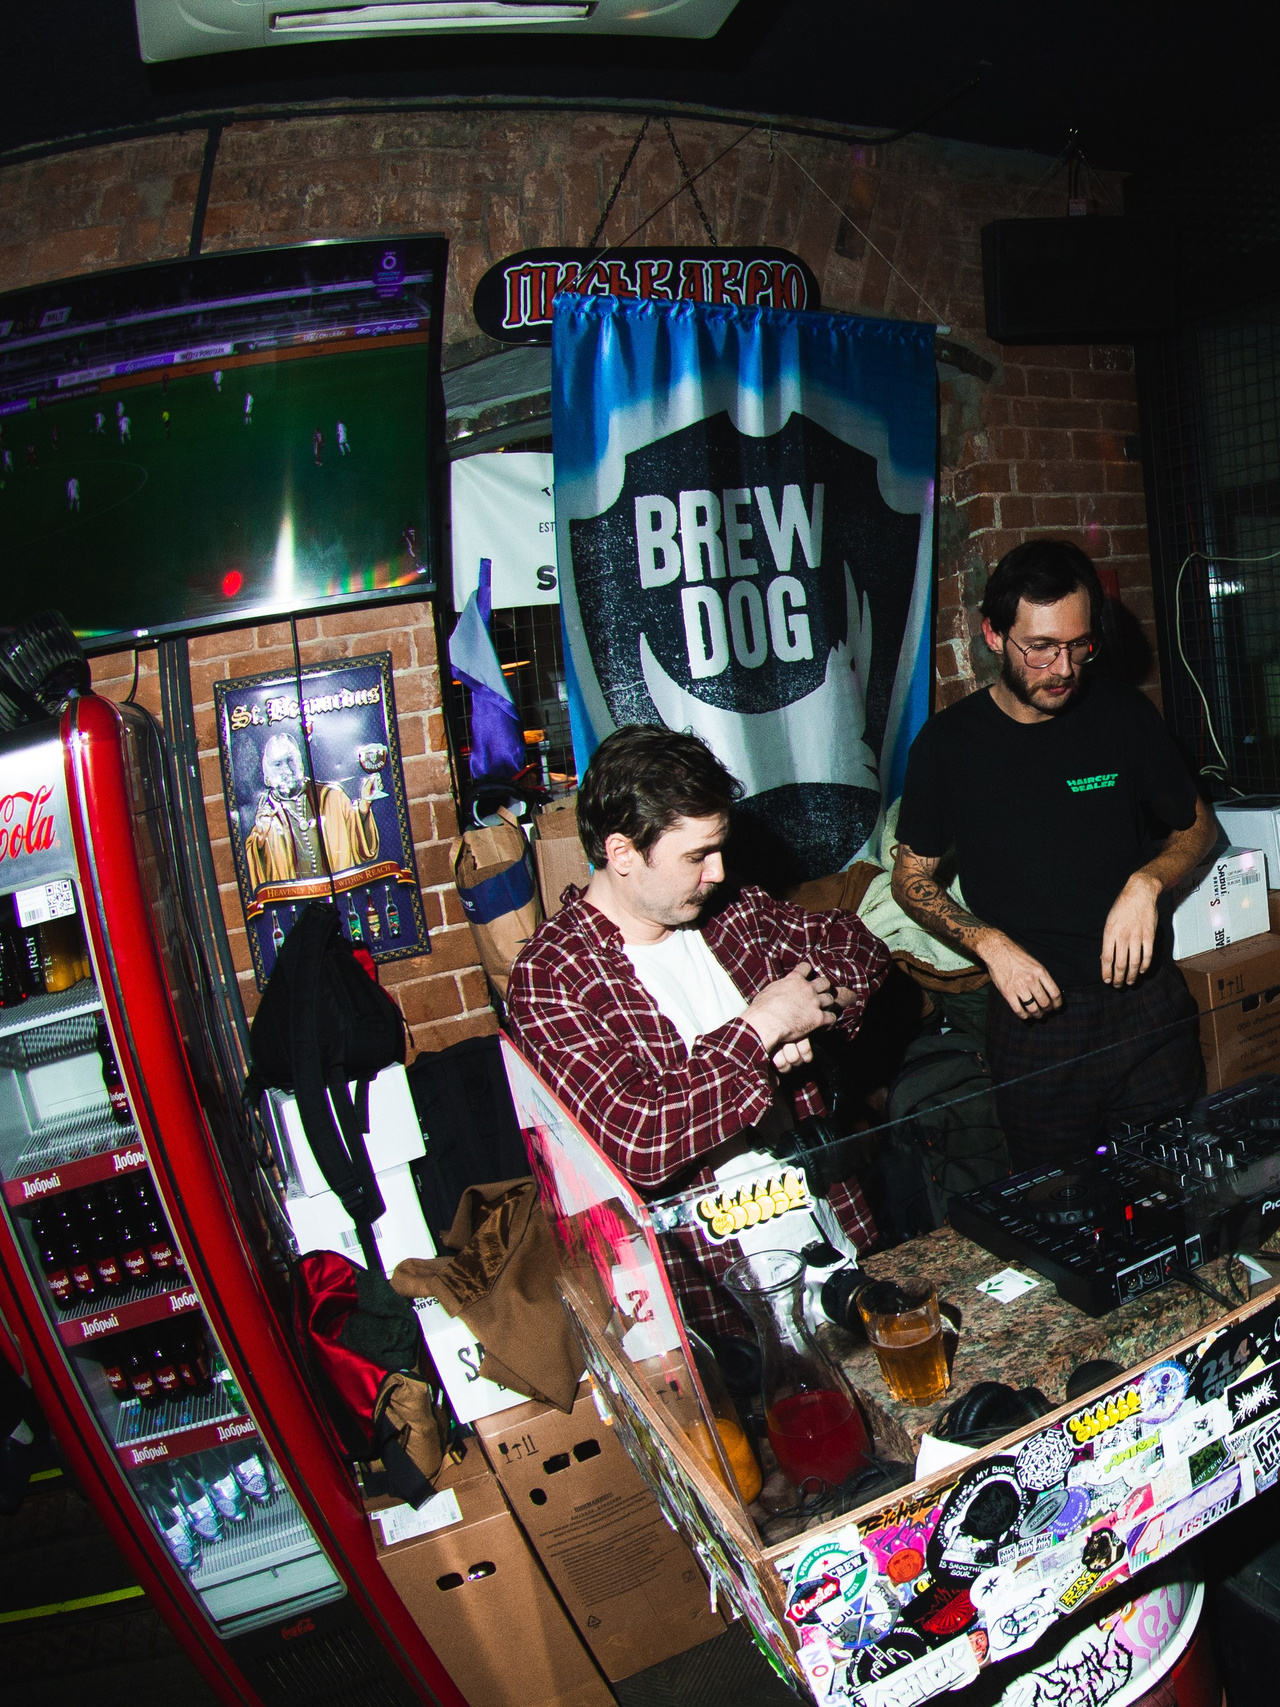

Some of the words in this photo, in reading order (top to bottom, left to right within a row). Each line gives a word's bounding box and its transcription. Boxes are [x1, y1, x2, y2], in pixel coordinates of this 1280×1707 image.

[634, 482, 825, 590] BREW
[680, 575, 814, 680] DOG
[266, 684, 381, 722] Benardus
[1066, 773, 1119, 787] HAIRCUT
[1070, 780, 1116, 793] DEALER
[266, 886, 306, 899] HEAVENLY
[365, 863, 392, 879] REACH
[23, 1173, 61, 1198] Добрый
[81, 1313, 119, 1338] Добрый
[1202, 1338, 1250, 1389] 214
[216, 1418, 256, 1441] Добрый
[131, 1442, 169, 1465] Добрый
[975, 1467, 989, 1482] MY
[991, 1465, 1016, 1475] BLOOD
[1029, 1500, 1060, 1529] ADJUSTABLE
[799, 1558, 814, 1577] PERM
[831, 1556, 863, 1579] CREW
[939, 1560, 947, 1569] IS
[950, 1569, 975, 1579] SOUR
